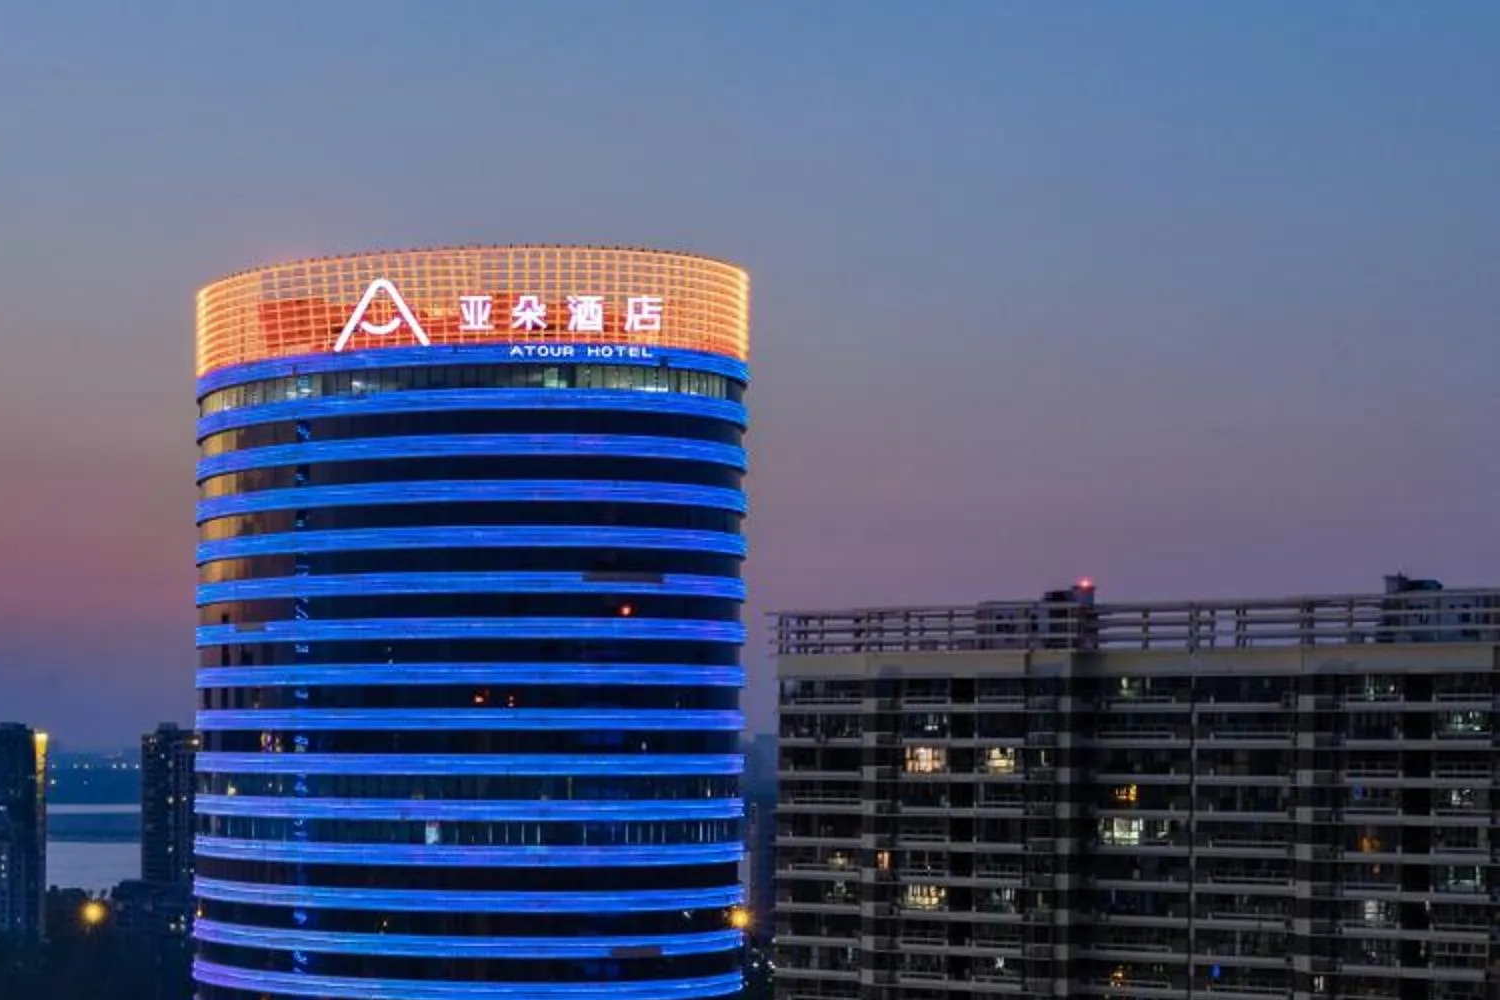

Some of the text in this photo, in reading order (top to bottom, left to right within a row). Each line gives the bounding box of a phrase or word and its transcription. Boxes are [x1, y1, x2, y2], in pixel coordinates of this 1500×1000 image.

[459, 295, 663, 332] 亚朵酒店
[509, 345, 654, 358] ATOUR HOTEL
